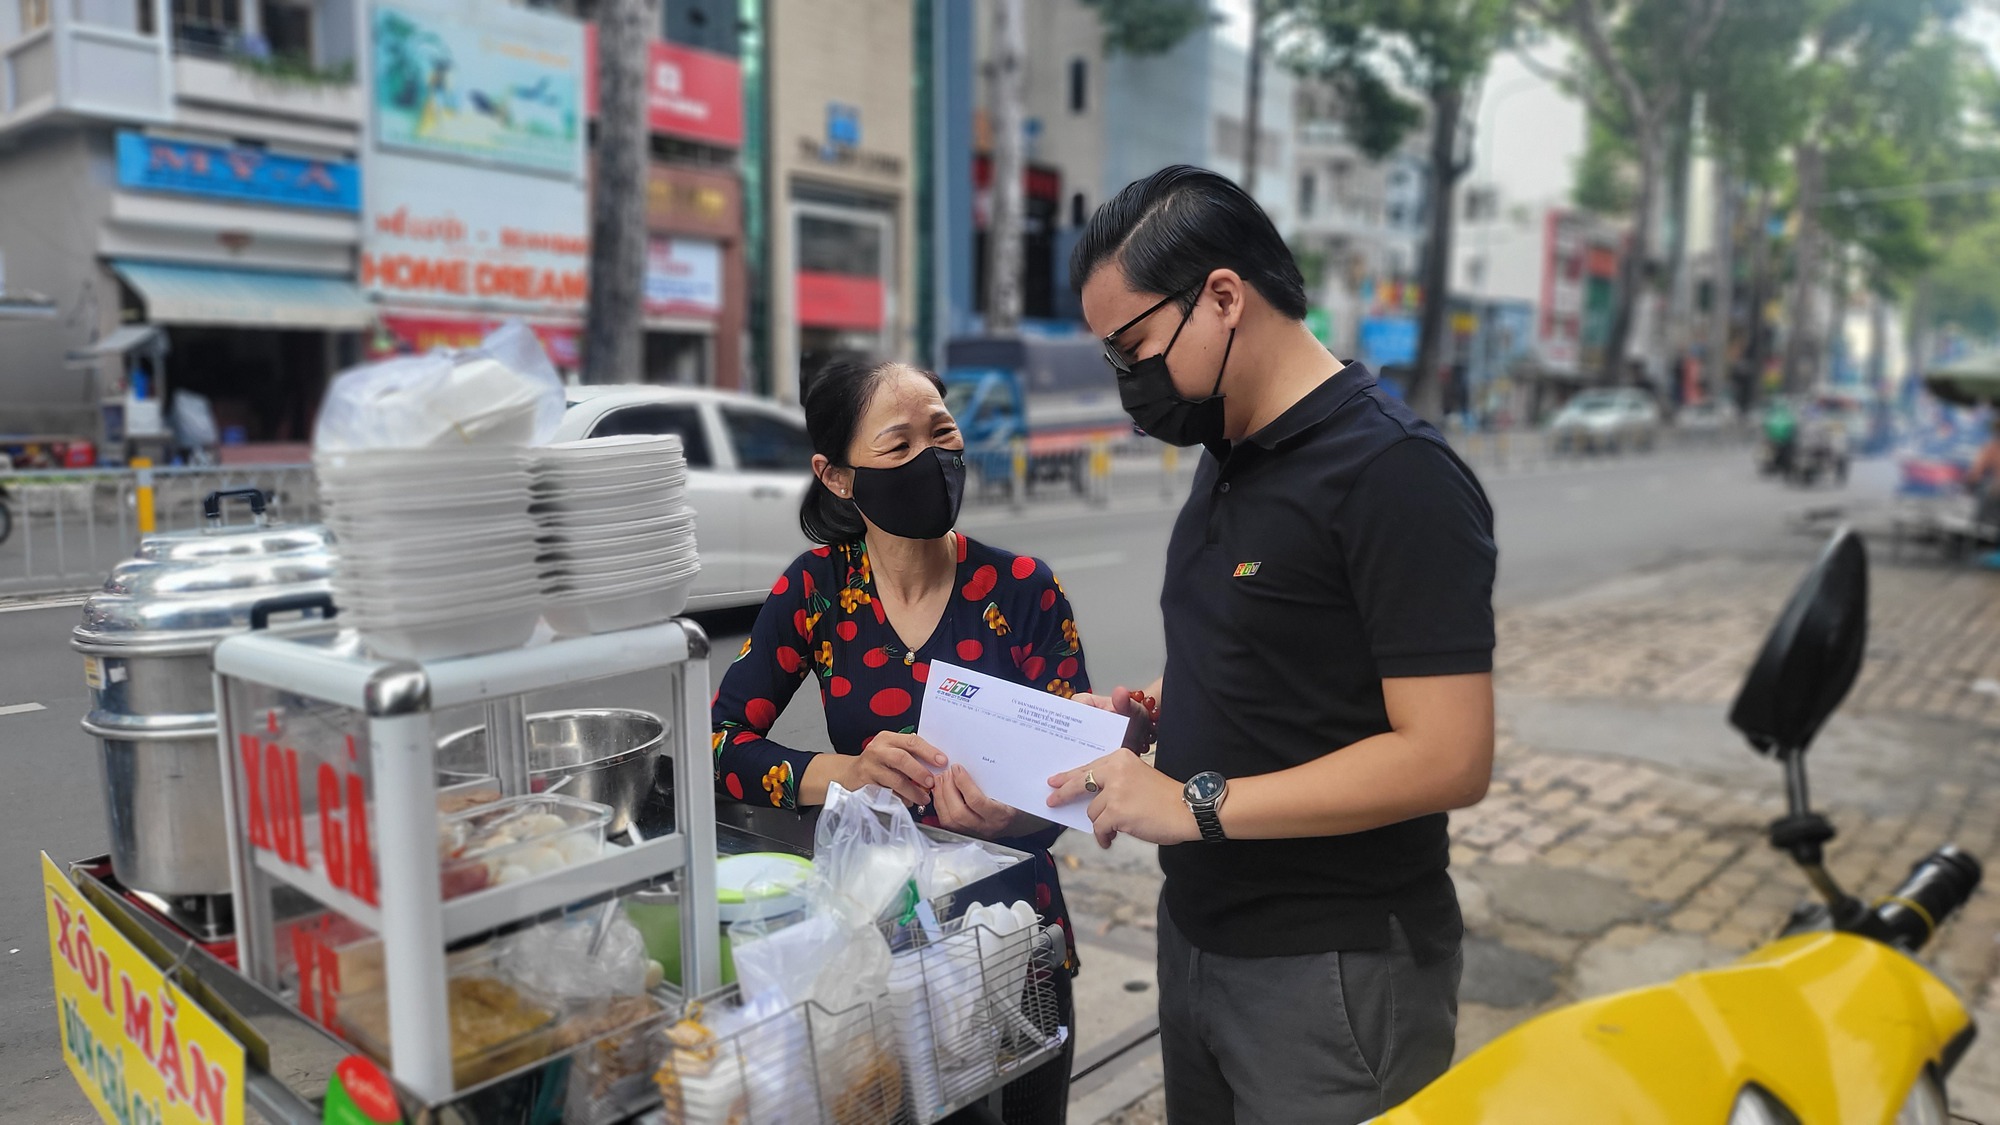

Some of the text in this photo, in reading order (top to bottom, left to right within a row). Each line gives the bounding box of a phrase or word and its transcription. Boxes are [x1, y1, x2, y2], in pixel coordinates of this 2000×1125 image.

[362, 254, 469, 296] HOME
[1233, 562, 1261, 577] HTV
[938, 677, 981, 699] HTV
[240, 710, 381, 909] XÔI GÀ
[53, 896, 227, 1125] XÔI MẶN
